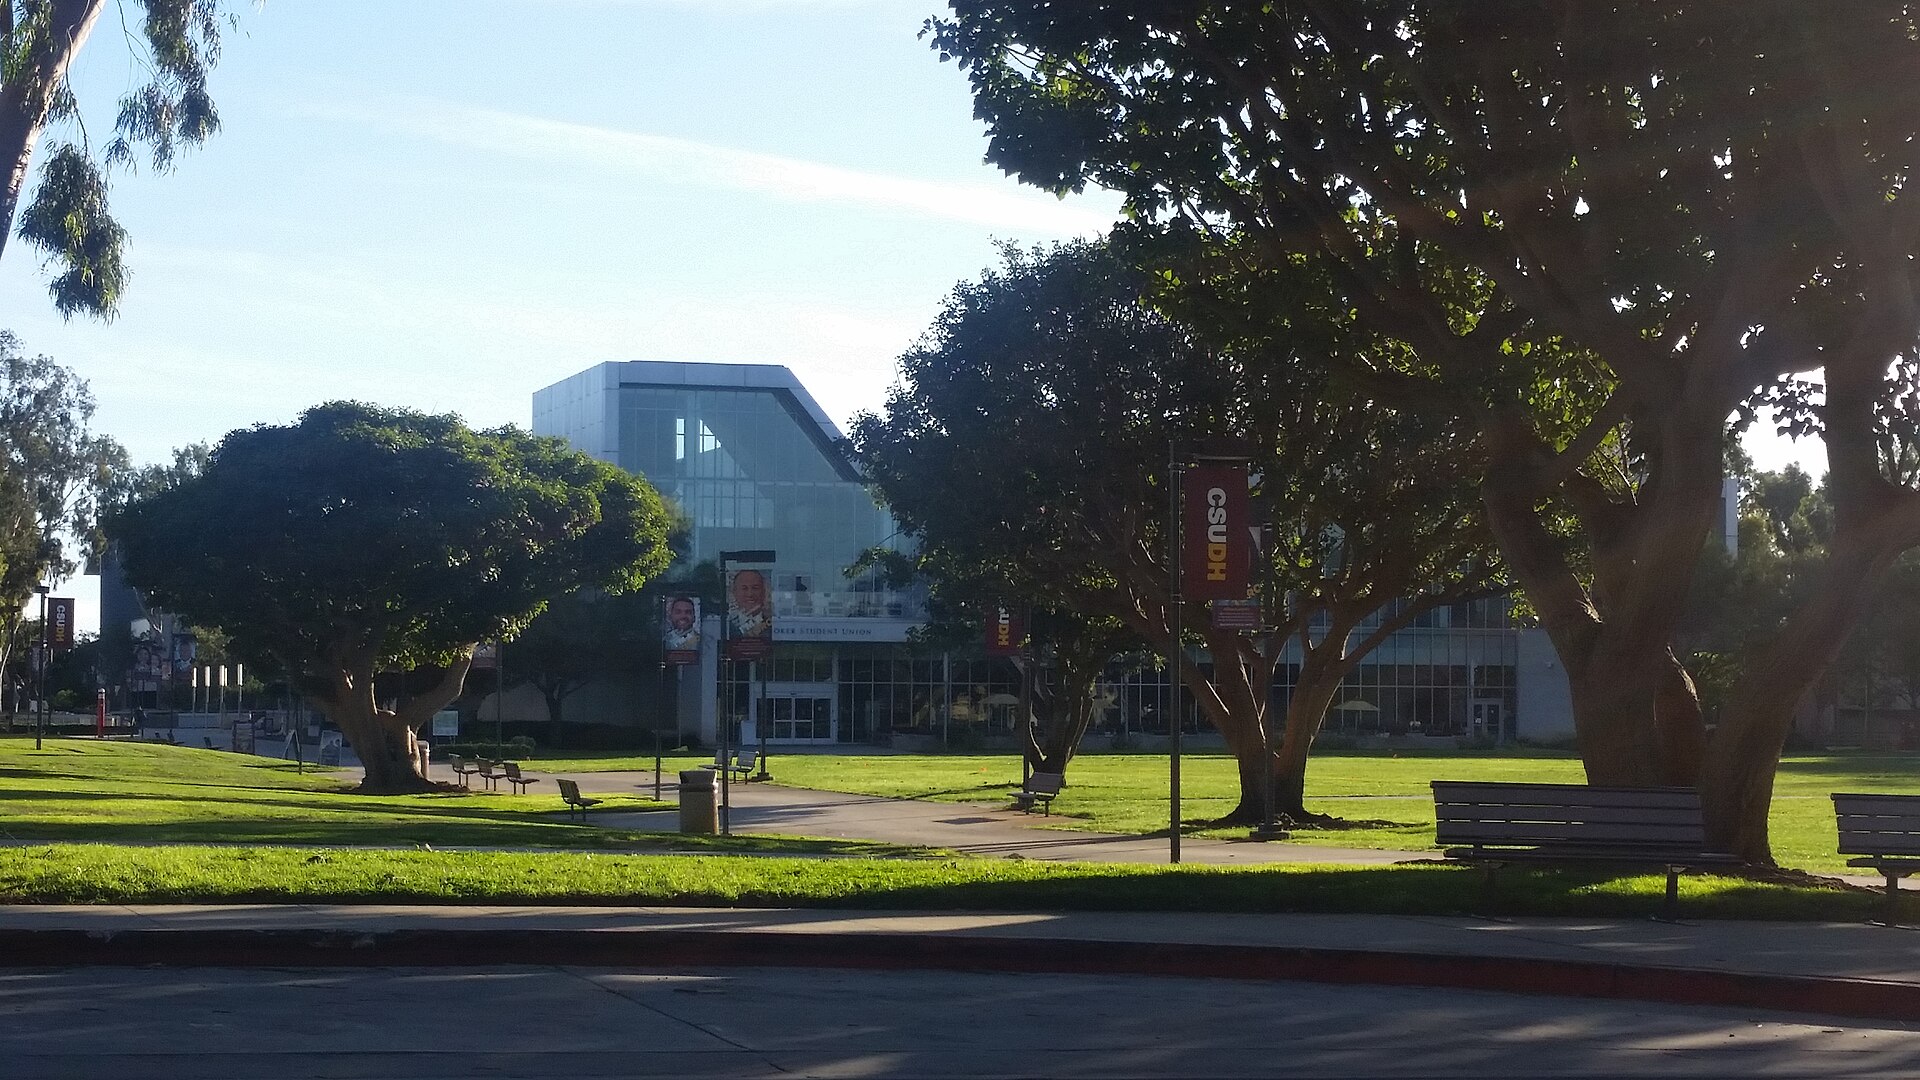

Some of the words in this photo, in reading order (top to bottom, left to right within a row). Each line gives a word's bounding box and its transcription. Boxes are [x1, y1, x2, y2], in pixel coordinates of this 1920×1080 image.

[1207, 487, 1227, 581] CSUDH
[56, 605, 66, 642] CSUDH
[773, 627, 796, 635] OKER
[800, 627, 838, 636] STUDENT
[842, 627, 872, 636] UNION
[998, 606, 1010, 646] UDH
